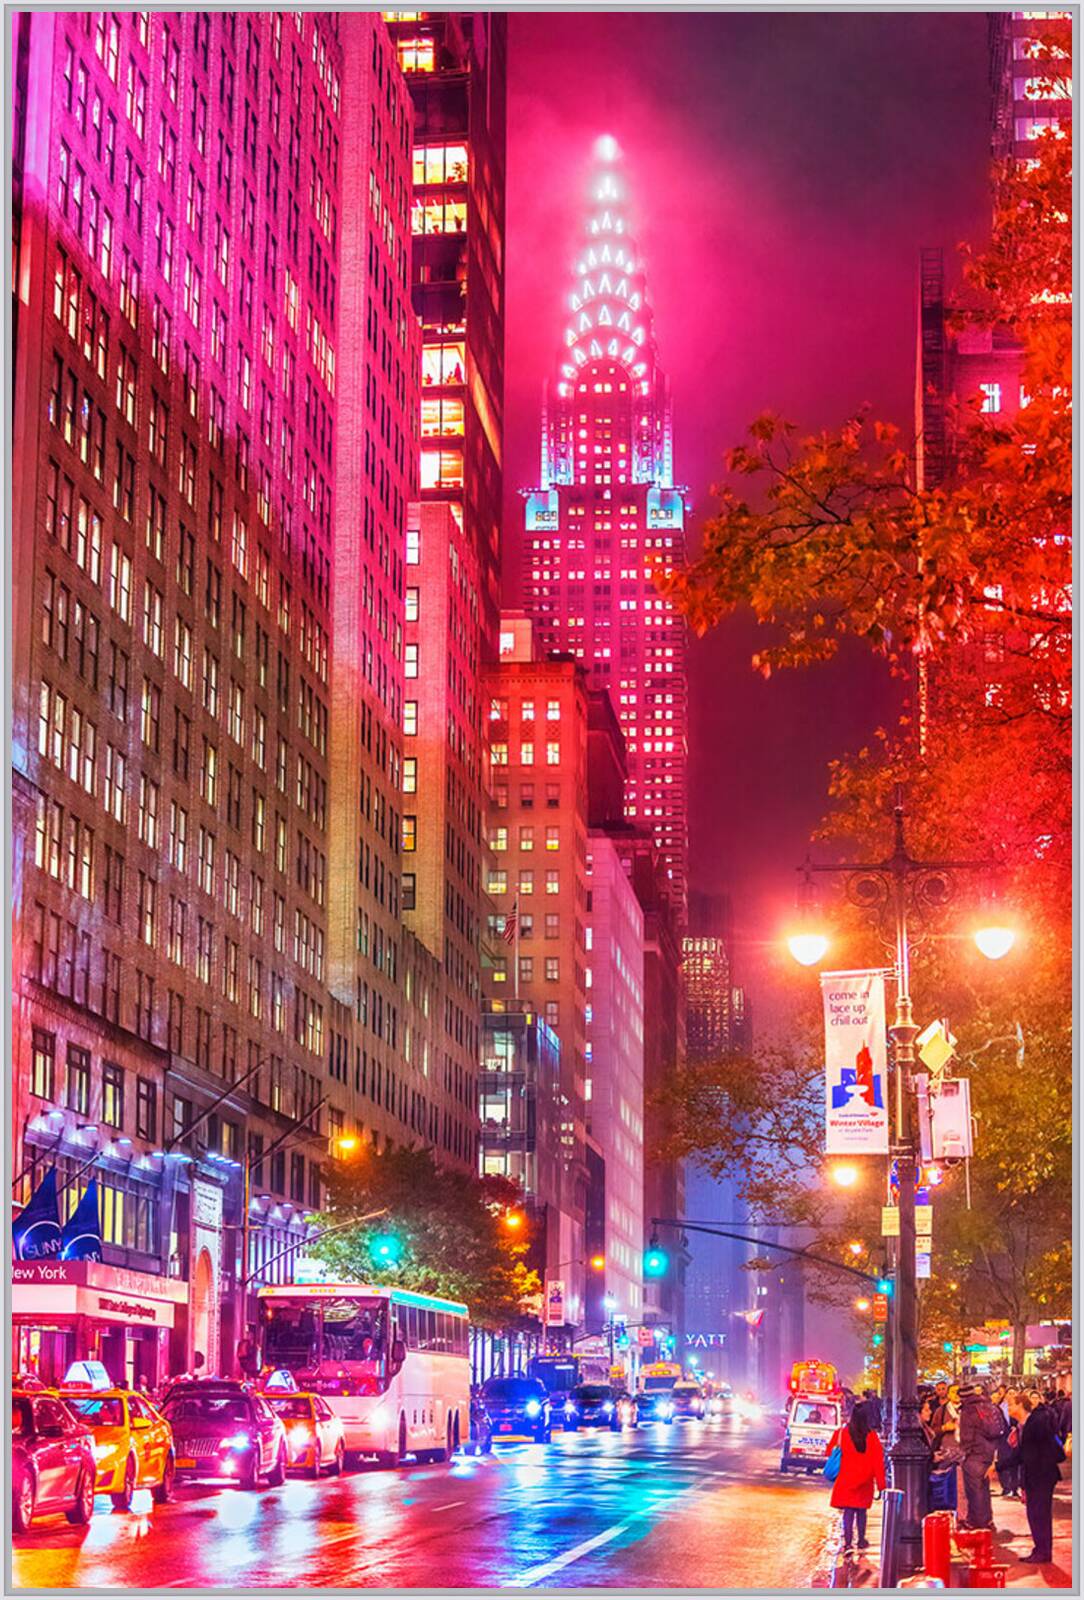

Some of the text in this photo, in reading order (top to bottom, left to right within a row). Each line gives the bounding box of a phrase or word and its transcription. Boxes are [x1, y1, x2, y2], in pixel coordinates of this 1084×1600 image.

[829, 990, 870, 1001] come in
[830, 1003, 866, 1015] lace up
[831, 1015, 868, 1026] chill out
[857, 1119, 885, 1129] Village
[27, 1238, 62, 1260] SUNY
[38, 1265, 67, 1280] York
